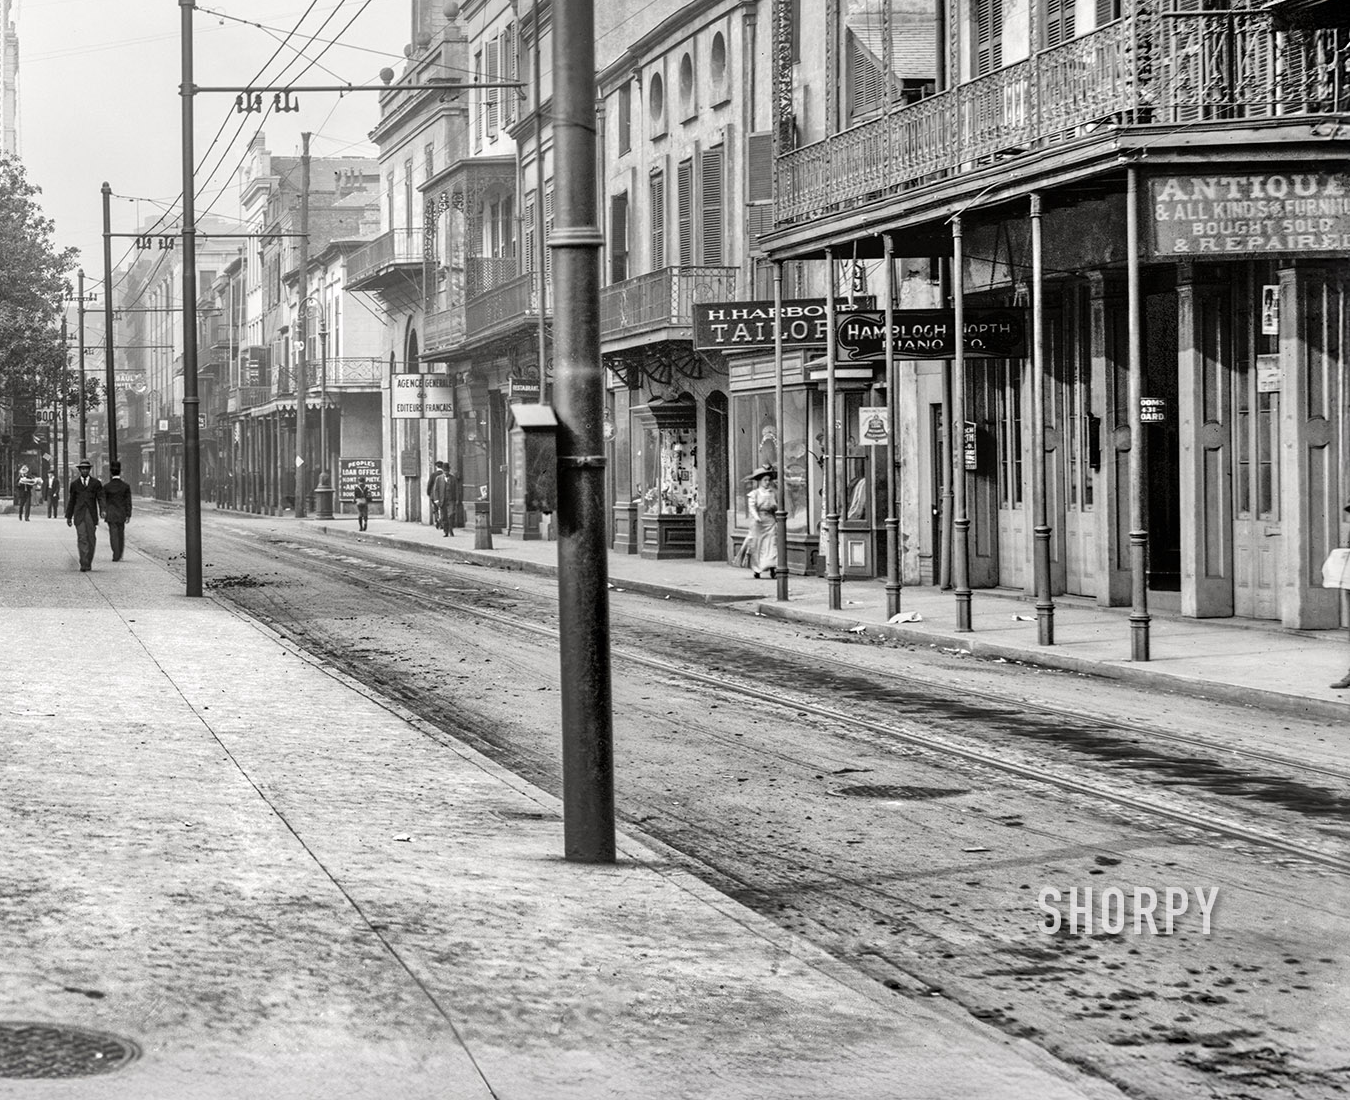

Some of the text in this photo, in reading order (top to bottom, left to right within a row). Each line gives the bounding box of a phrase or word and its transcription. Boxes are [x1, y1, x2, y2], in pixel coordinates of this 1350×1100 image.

[1155, 204, 1170, 221] &
[1174, 203, 1208, 220] ALL
[1214, 201, 1268, 218] KINDS
[1193, 219, 1332, 235] BOUGHT SOLD
[1175, 238, 1190, 252] &
[963, 323, 1011, 337] ORTH
[1140, 412, 1165, 421] OARD
